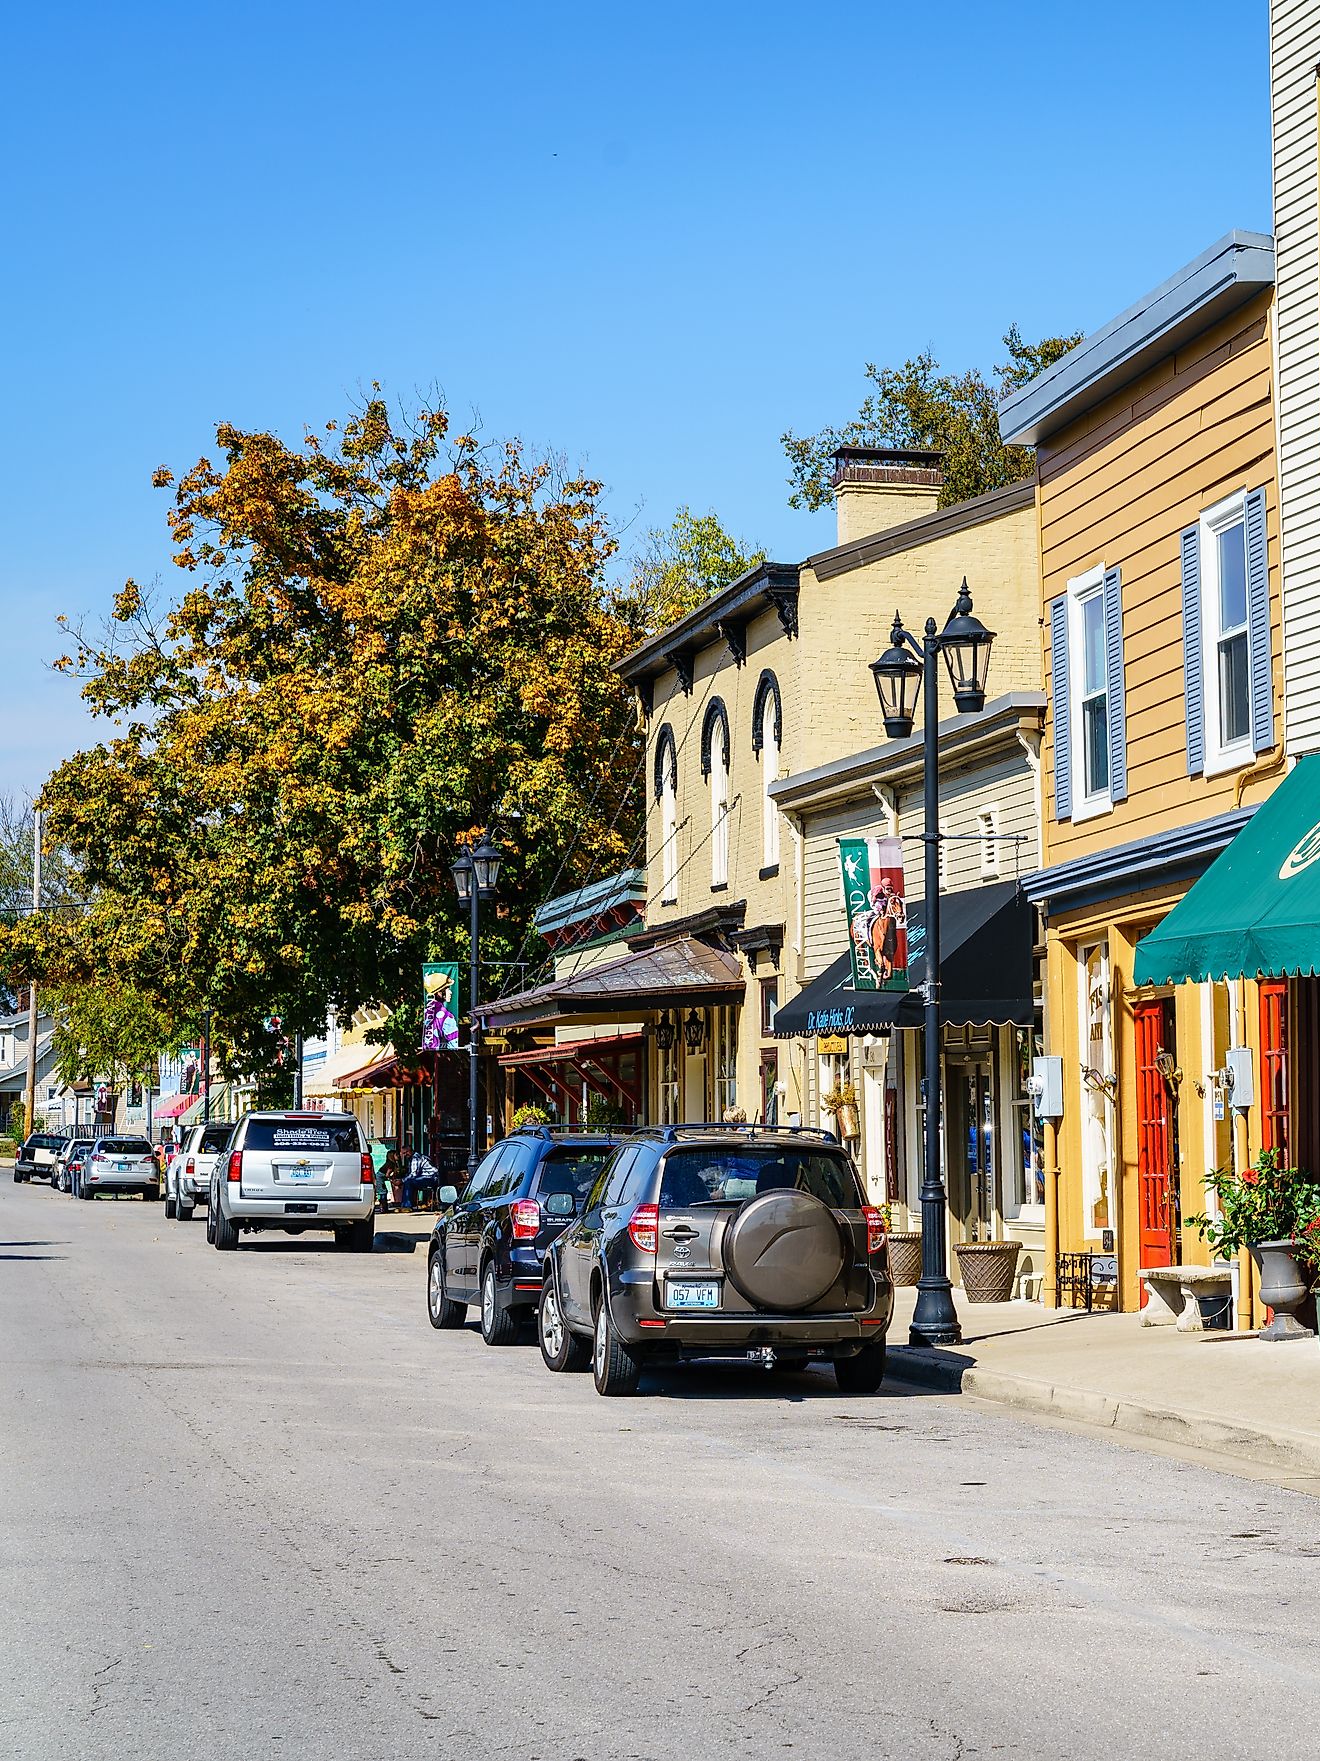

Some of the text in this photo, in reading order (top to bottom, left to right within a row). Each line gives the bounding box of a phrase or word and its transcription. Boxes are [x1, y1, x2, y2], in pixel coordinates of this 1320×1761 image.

[844, 1006, 855, 1026] DC
[673, 1289, 713, 1301] 057 VFM
